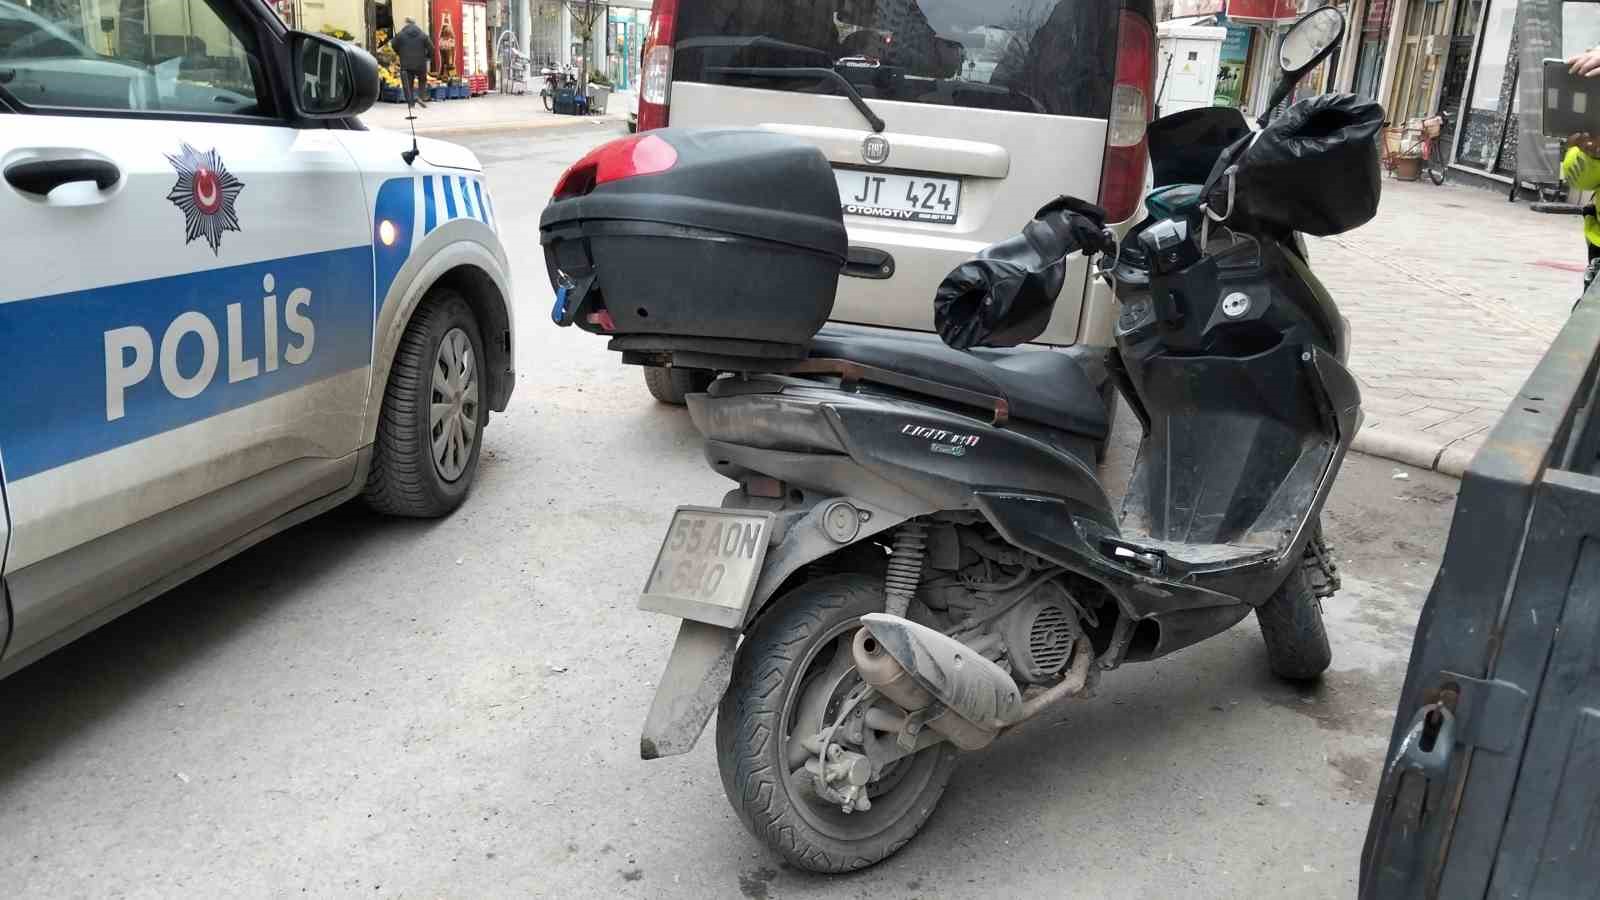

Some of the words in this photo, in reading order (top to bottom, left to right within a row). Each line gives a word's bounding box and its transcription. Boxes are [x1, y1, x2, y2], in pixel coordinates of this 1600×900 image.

[867, 142, 884, 157] FIAT
[854, 176, 886, 204] JT
[905, 181, 951, 211] 424
[104, 273, 315, 422] POLİS
